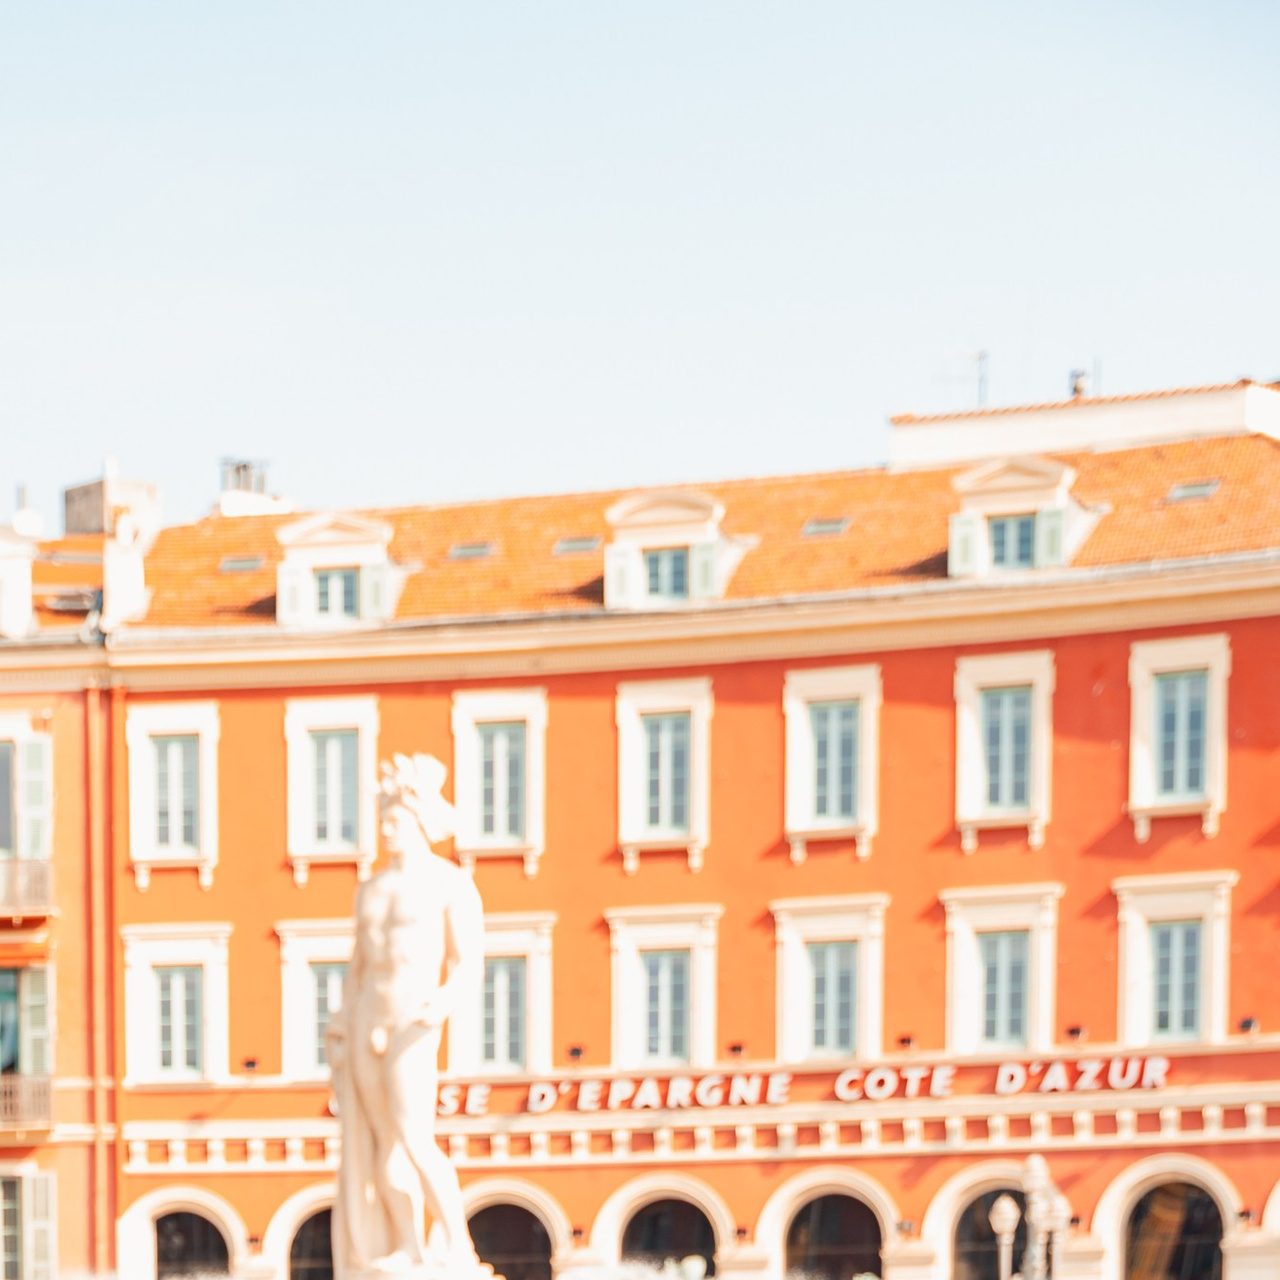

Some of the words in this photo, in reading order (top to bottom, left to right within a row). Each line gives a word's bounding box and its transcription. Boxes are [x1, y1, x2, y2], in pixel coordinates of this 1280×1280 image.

[527, 1073, 792, 1112] D'EPARGNE
[834, 1065, 958, 1101] COTE
[995, 1056, 1170, 1096] D'AZUR
